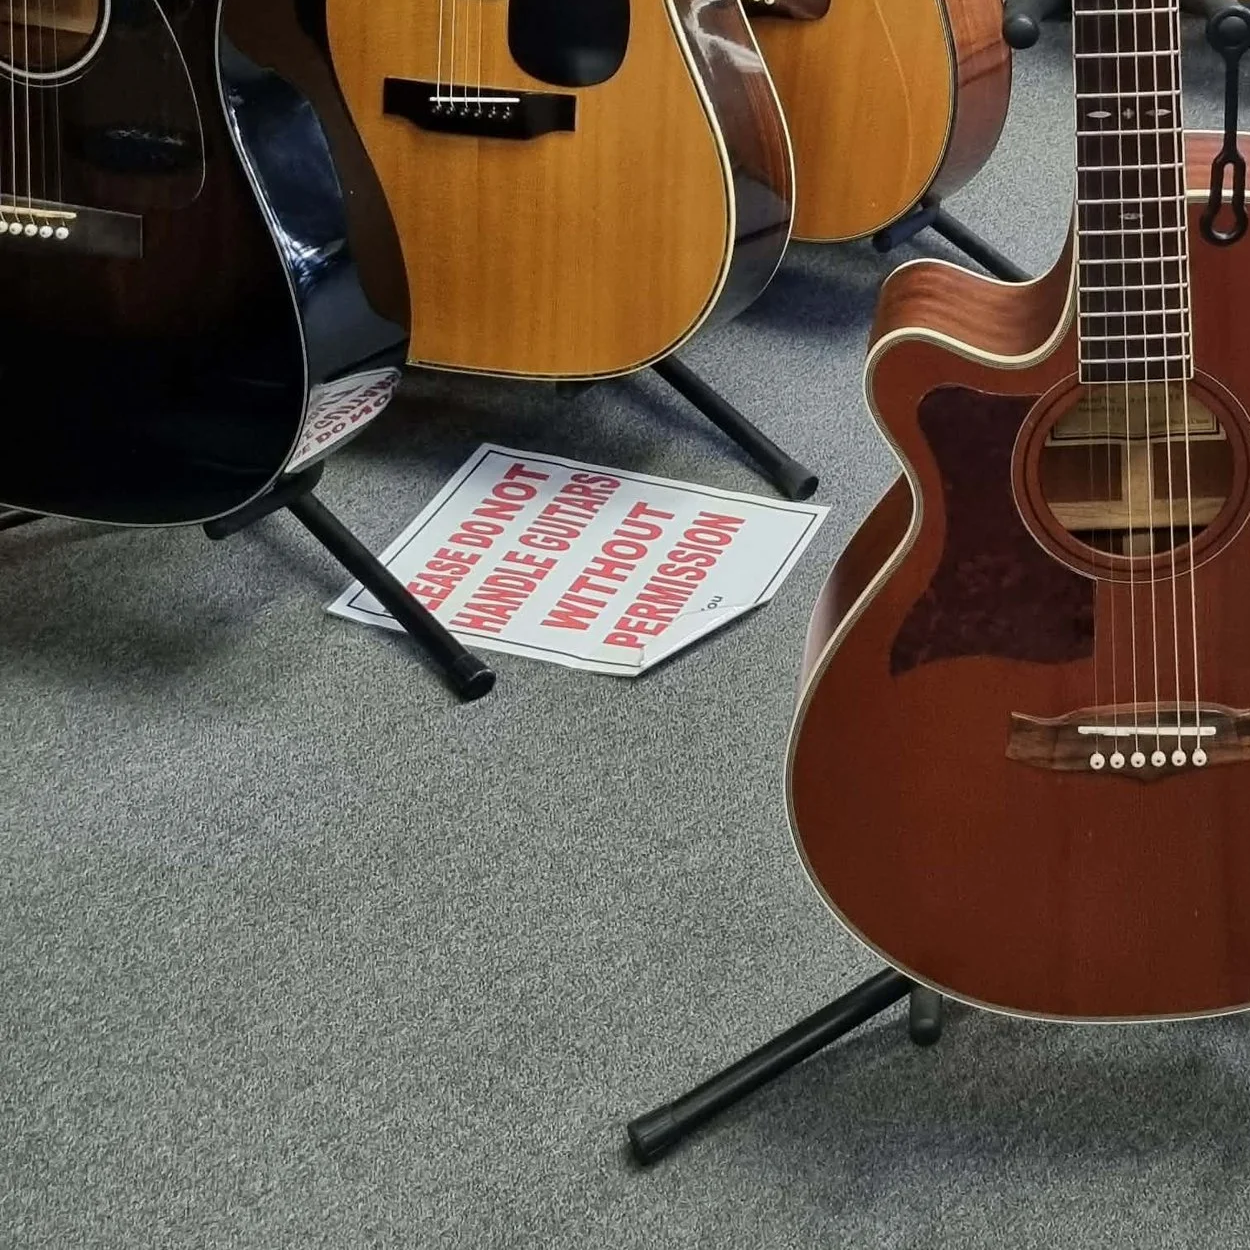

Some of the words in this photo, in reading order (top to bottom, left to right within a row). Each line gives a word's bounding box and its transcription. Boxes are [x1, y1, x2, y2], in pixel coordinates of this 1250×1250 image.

[447, 520, 505, 549] DO
[471, 463, 551, 522] NOT
[406, 547, 483, 611] LEASE
[448, 550, 559, 633] HANDLE
[518, 472, 622, 552] GUITARS
[540, 501, 676, 631] WITHOUT
[603, 511, 746, 649] PERMISSION
